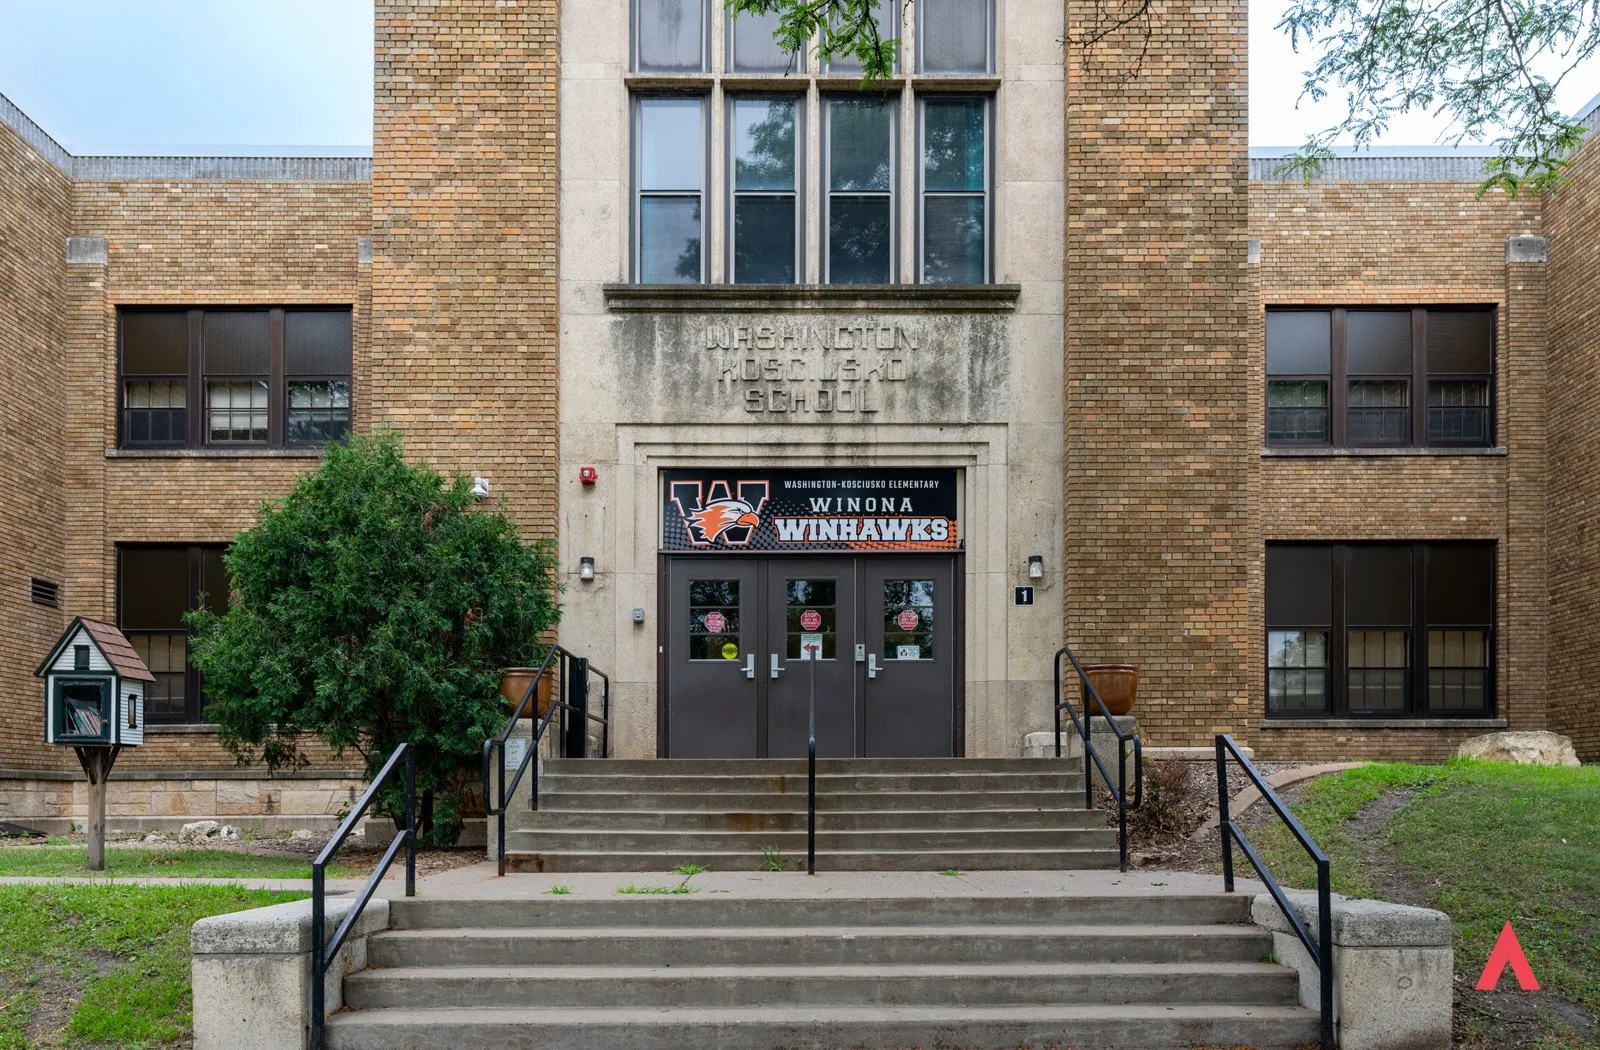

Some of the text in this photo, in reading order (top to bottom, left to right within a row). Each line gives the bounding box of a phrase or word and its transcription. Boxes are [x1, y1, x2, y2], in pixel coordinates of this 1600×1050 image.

[705, 325, 919, 350] WASHINGTON
[717, 358, 908, 381] KOSCIUSKO
[744, 388, 879, 413] SCHOOL
[784, 480, 940, 489] WASHINGTON-KOSCIUSKO ELEMENTARY
[809, 497, 913, 513] WINONA
[773, 516, 951, 543] WINHAWKS
[1021, 590, 1028, 602] 1
